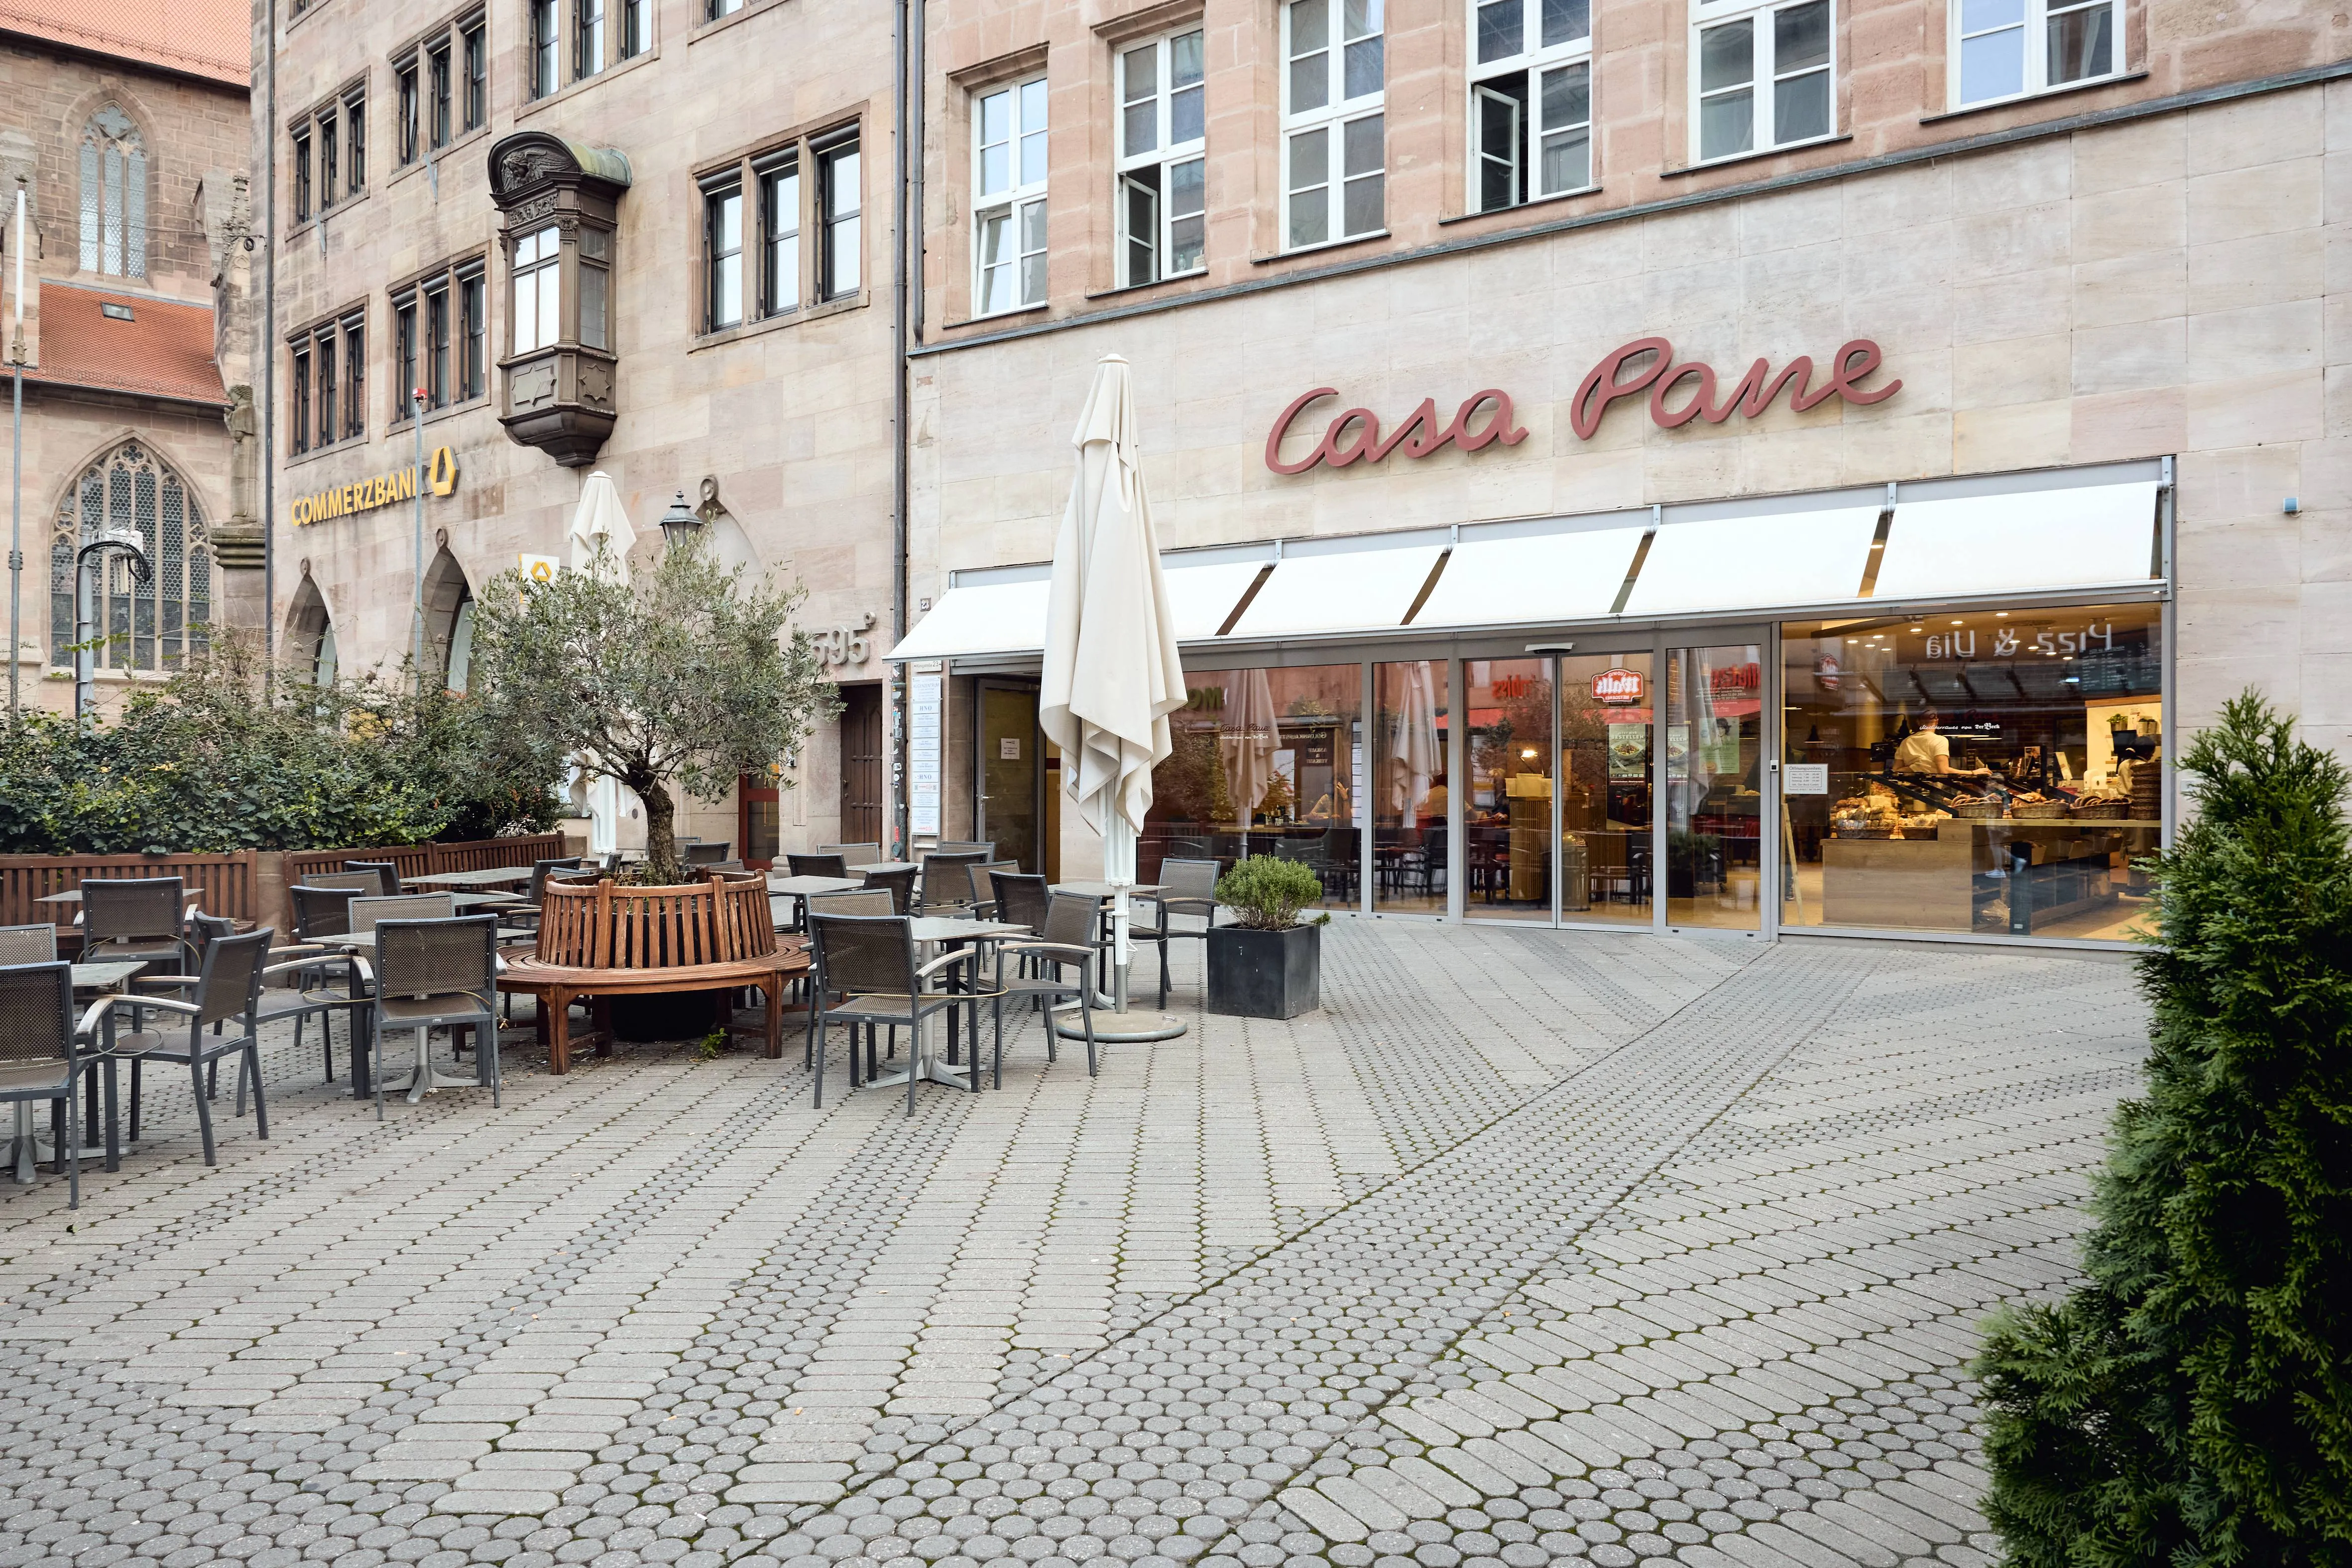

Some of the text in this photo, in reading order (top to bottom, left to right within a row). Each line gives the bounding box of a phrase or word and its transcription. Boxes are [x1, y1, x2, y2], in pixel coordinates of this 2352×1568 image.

[1264, 336, 1903, 475] Casa Pane
[921, 599, 930, 611] 23
[1220, 724, 1244, 732] Casa
